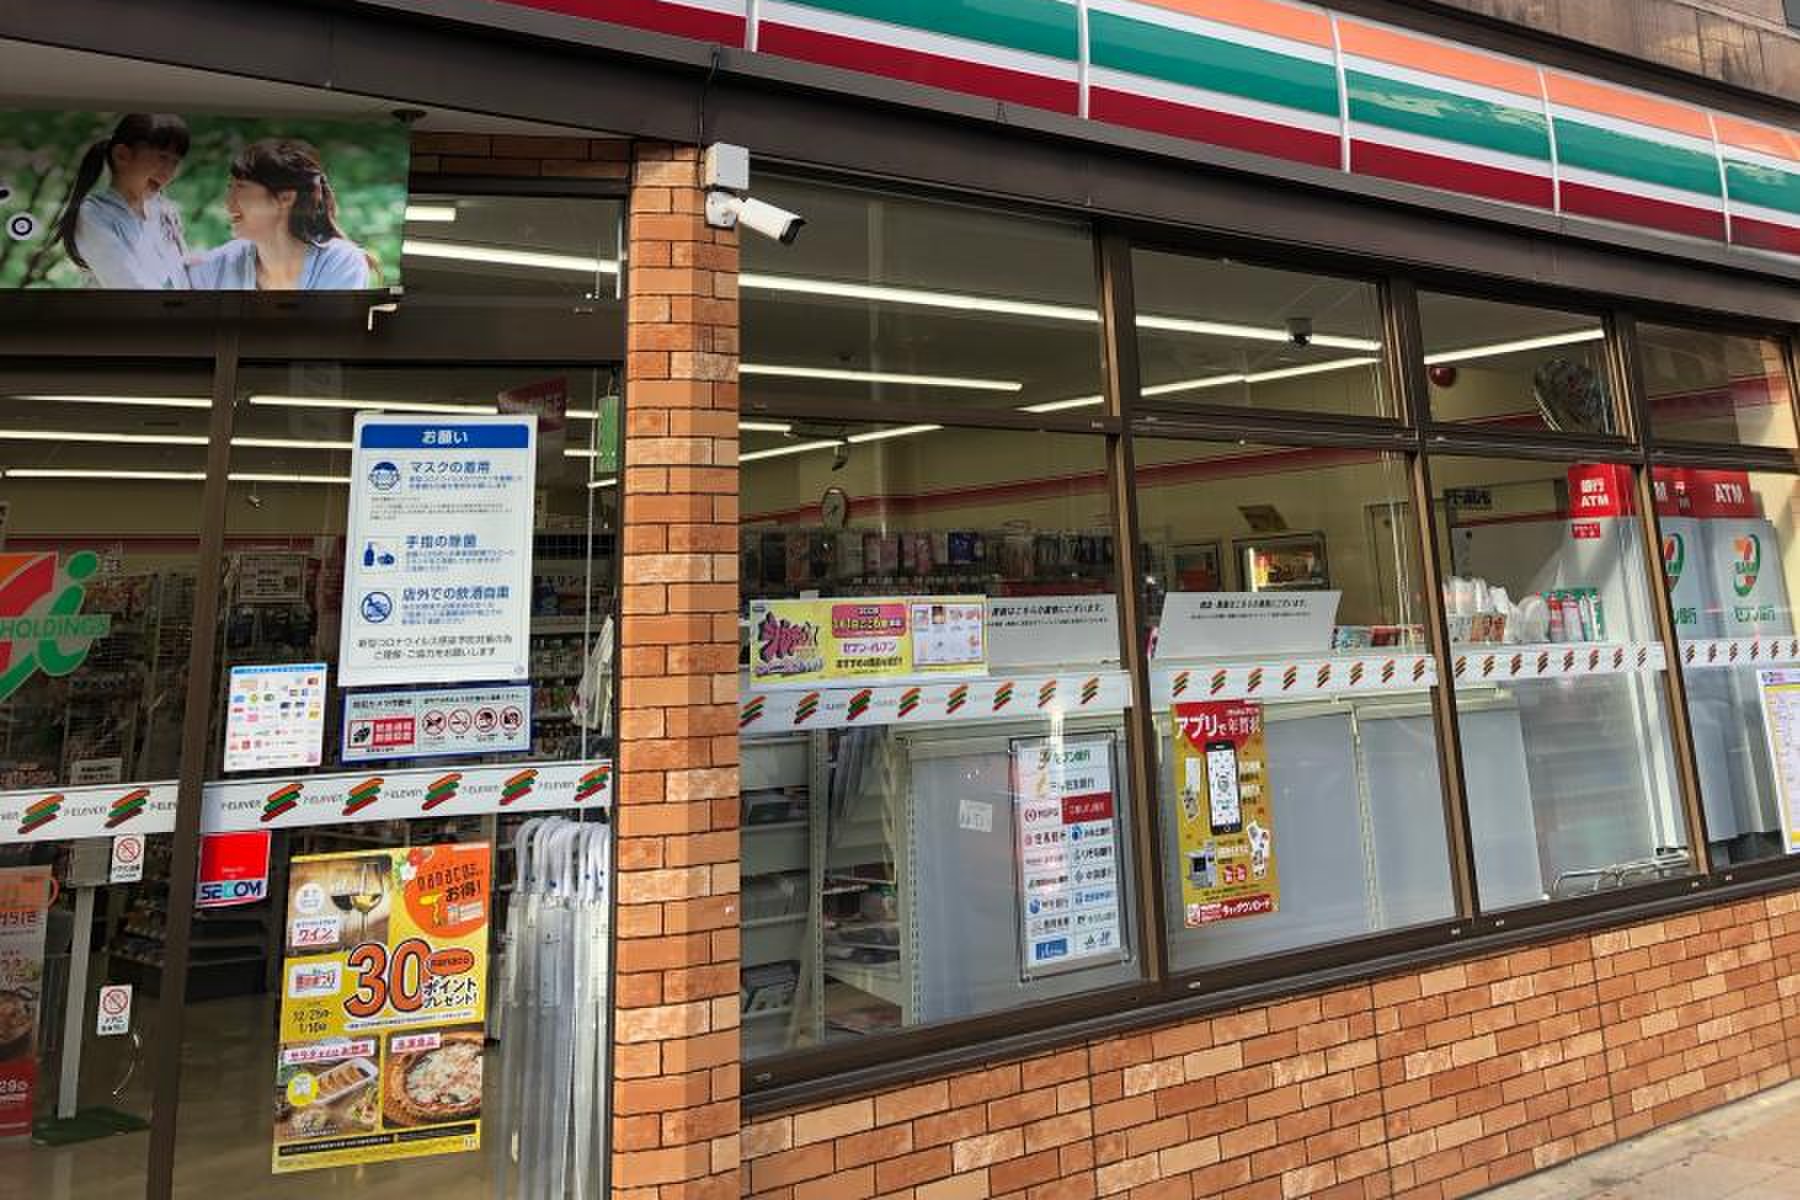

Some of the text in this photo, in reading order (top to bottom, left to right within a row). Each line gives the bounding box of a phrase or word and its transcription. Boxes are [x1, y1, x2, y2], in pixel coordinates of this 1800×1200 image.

[421, 429, 469, 445] お願い
[410, 461, 491, 474] マスクの着用
[1714, 482, 1745, 504] ATM
[1582, 494, 1609, 509] ATM
[405, 534, 478, 549] 手指の除菌
[344, 937, 432, 1014] 30
[423, 976, 477, 996] ポイント
